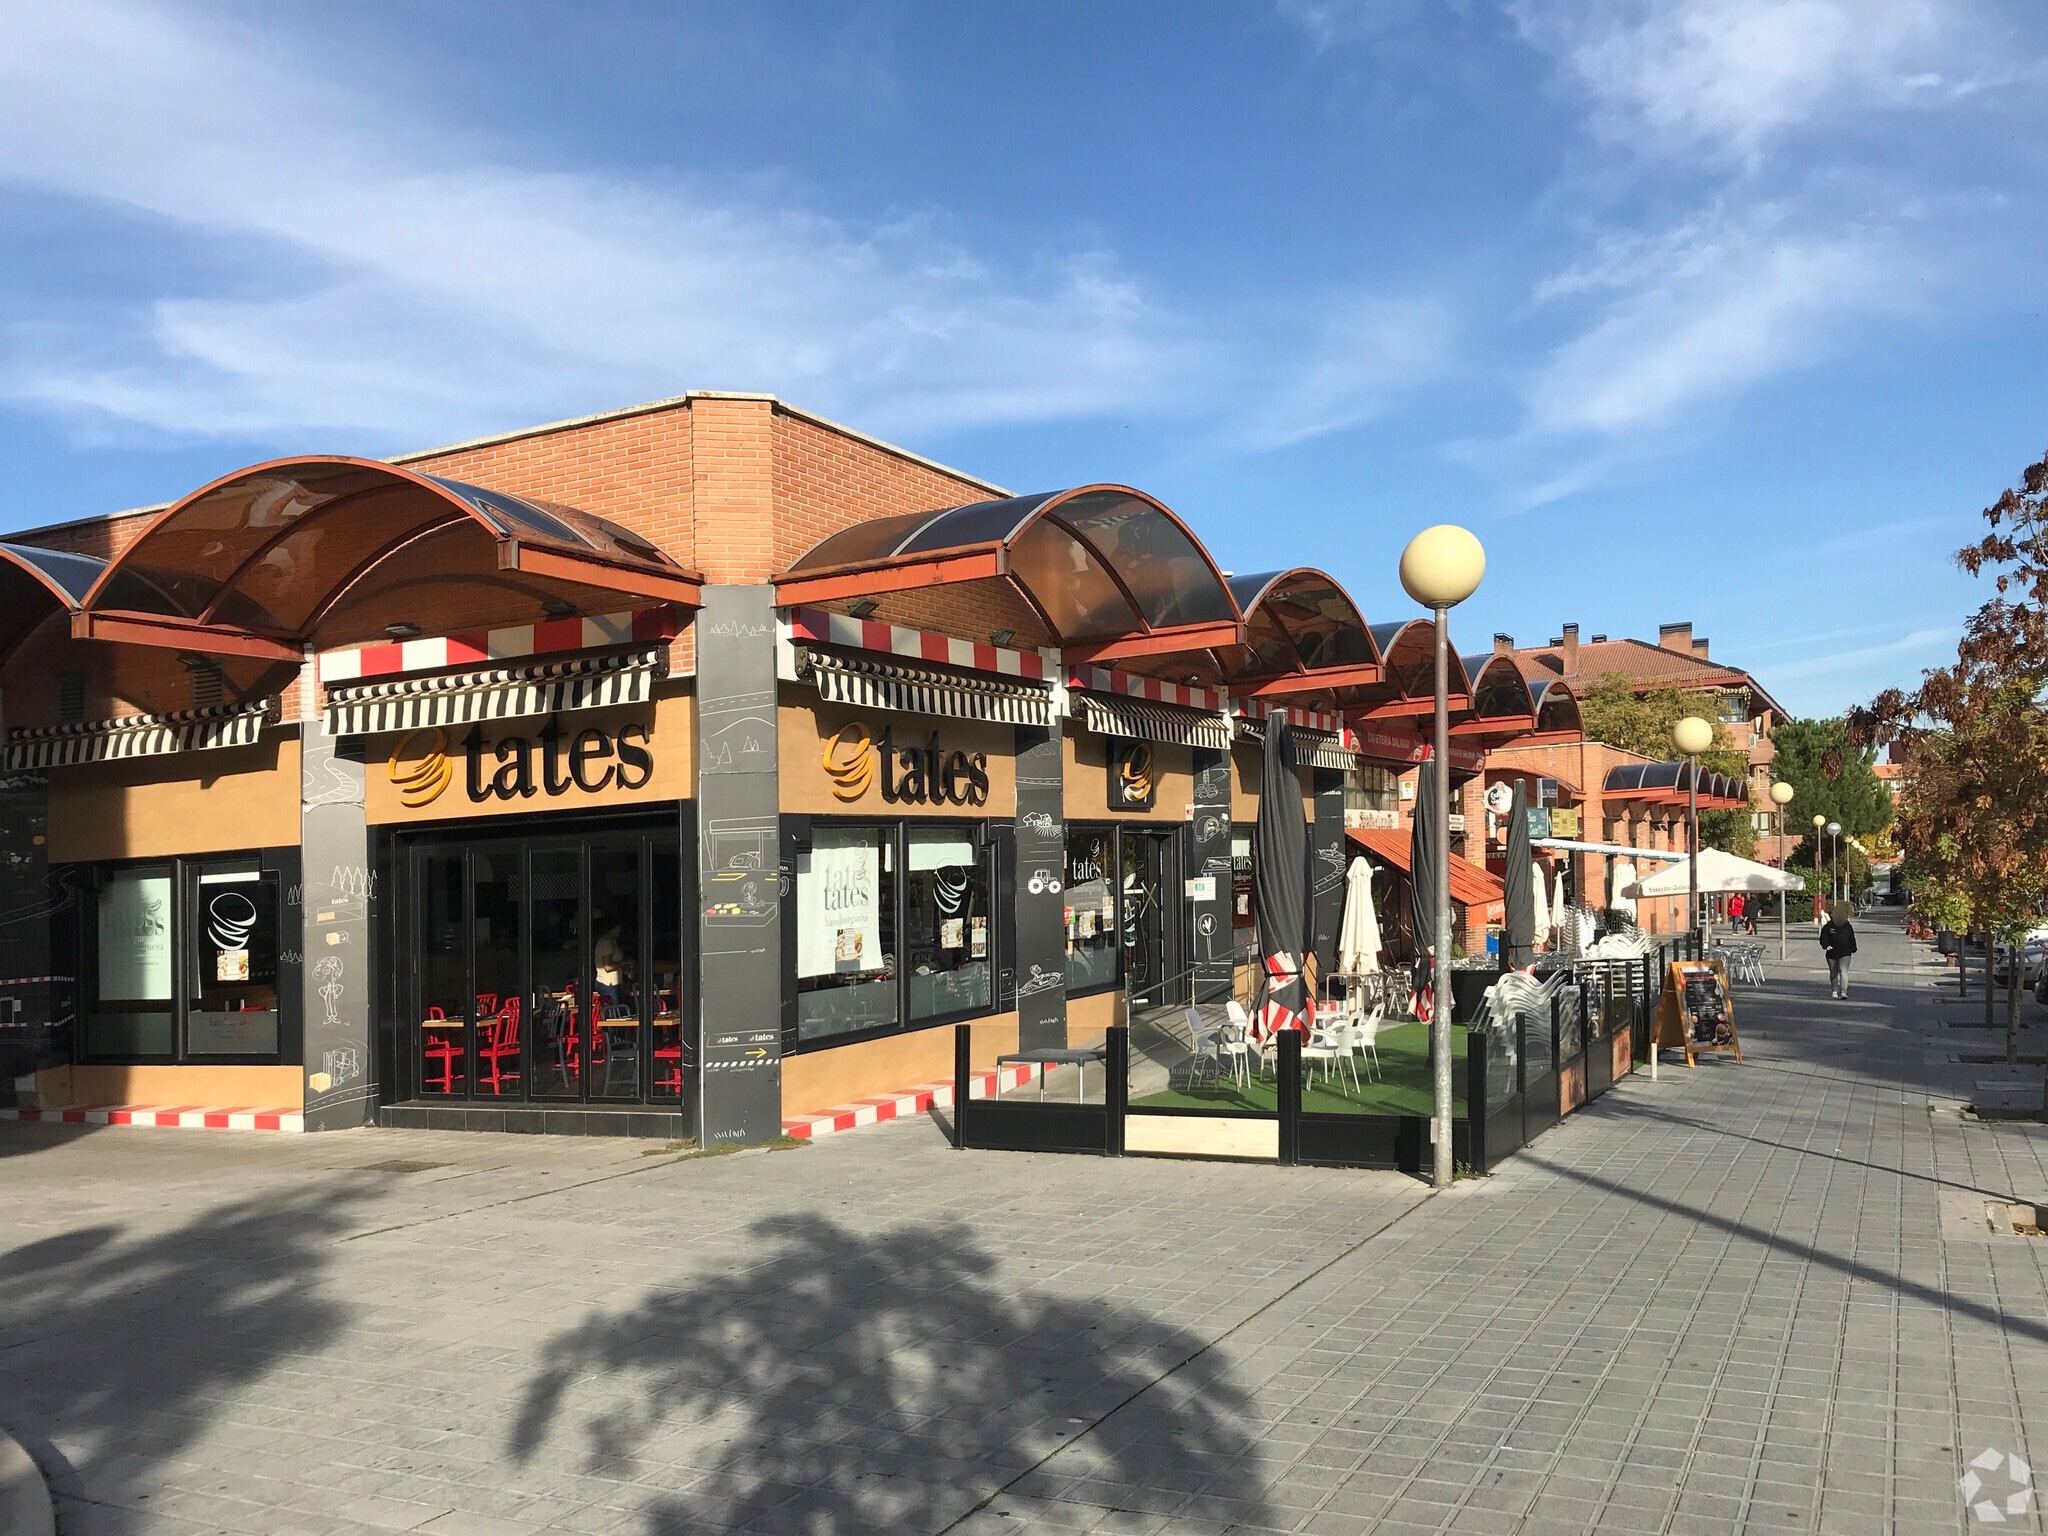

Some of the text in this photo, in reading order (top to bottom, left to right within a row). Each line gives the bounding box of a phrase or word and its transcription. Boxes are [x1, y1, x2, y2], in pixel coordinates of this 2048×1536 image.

[460, 713, 654, 803] tates
[876, 725, 990, 807] tates
[1072, 857, 1102, 880] tates
[823, 883, 869, 911] tates
[755, 1033, 775, 1042] tates
